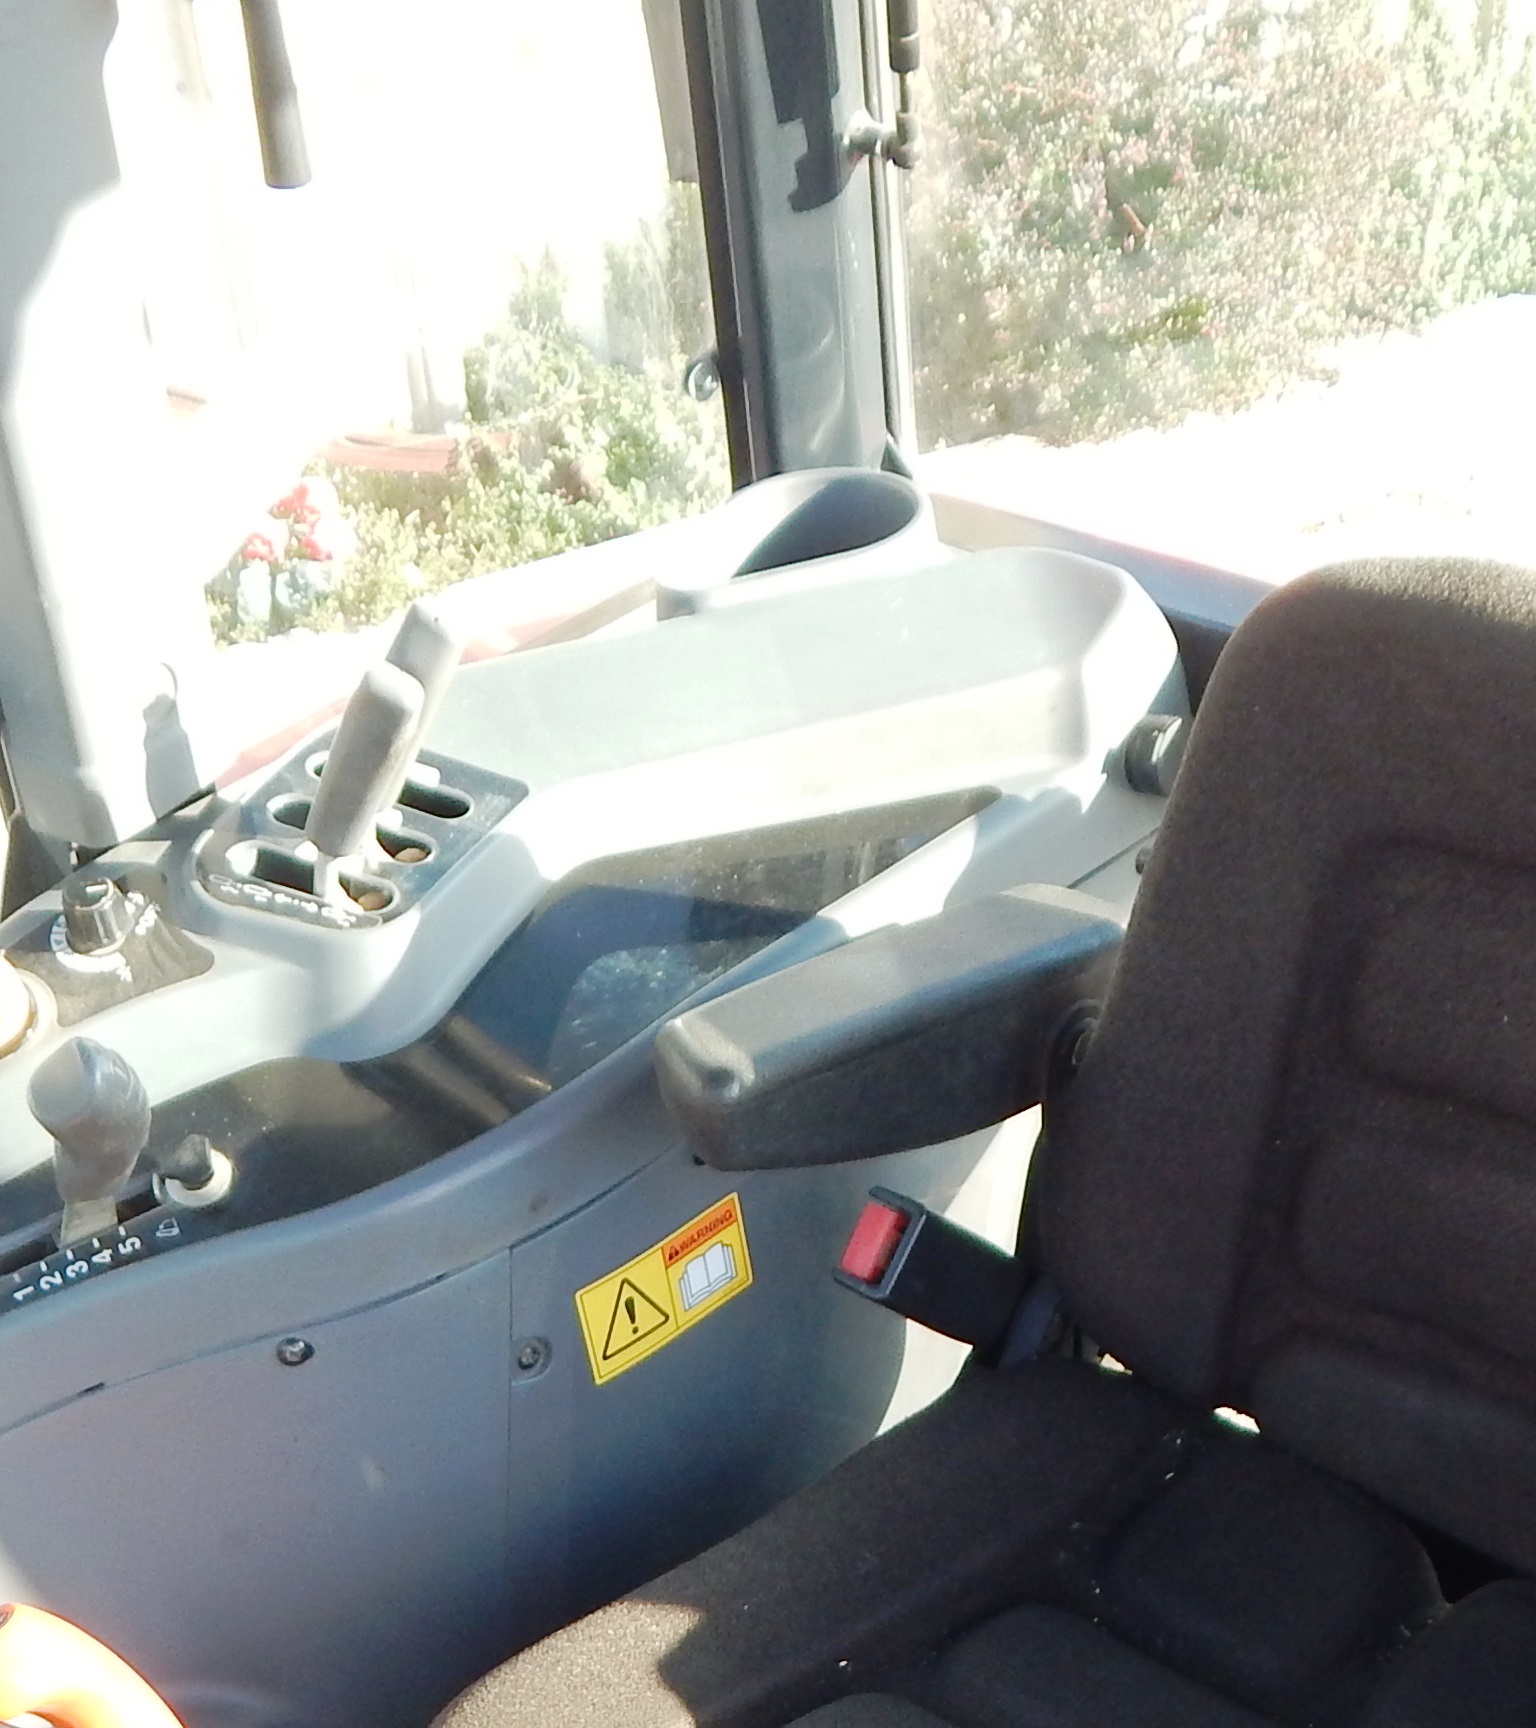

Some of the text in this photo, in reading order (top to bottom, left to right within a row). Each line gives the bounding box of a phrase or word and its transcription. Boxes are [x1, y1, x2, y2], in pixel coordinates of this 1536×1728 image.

[679, 1209, 733, 1252] WARNING
[13, 1236, 142, 1301] 1 2 3 4 5
